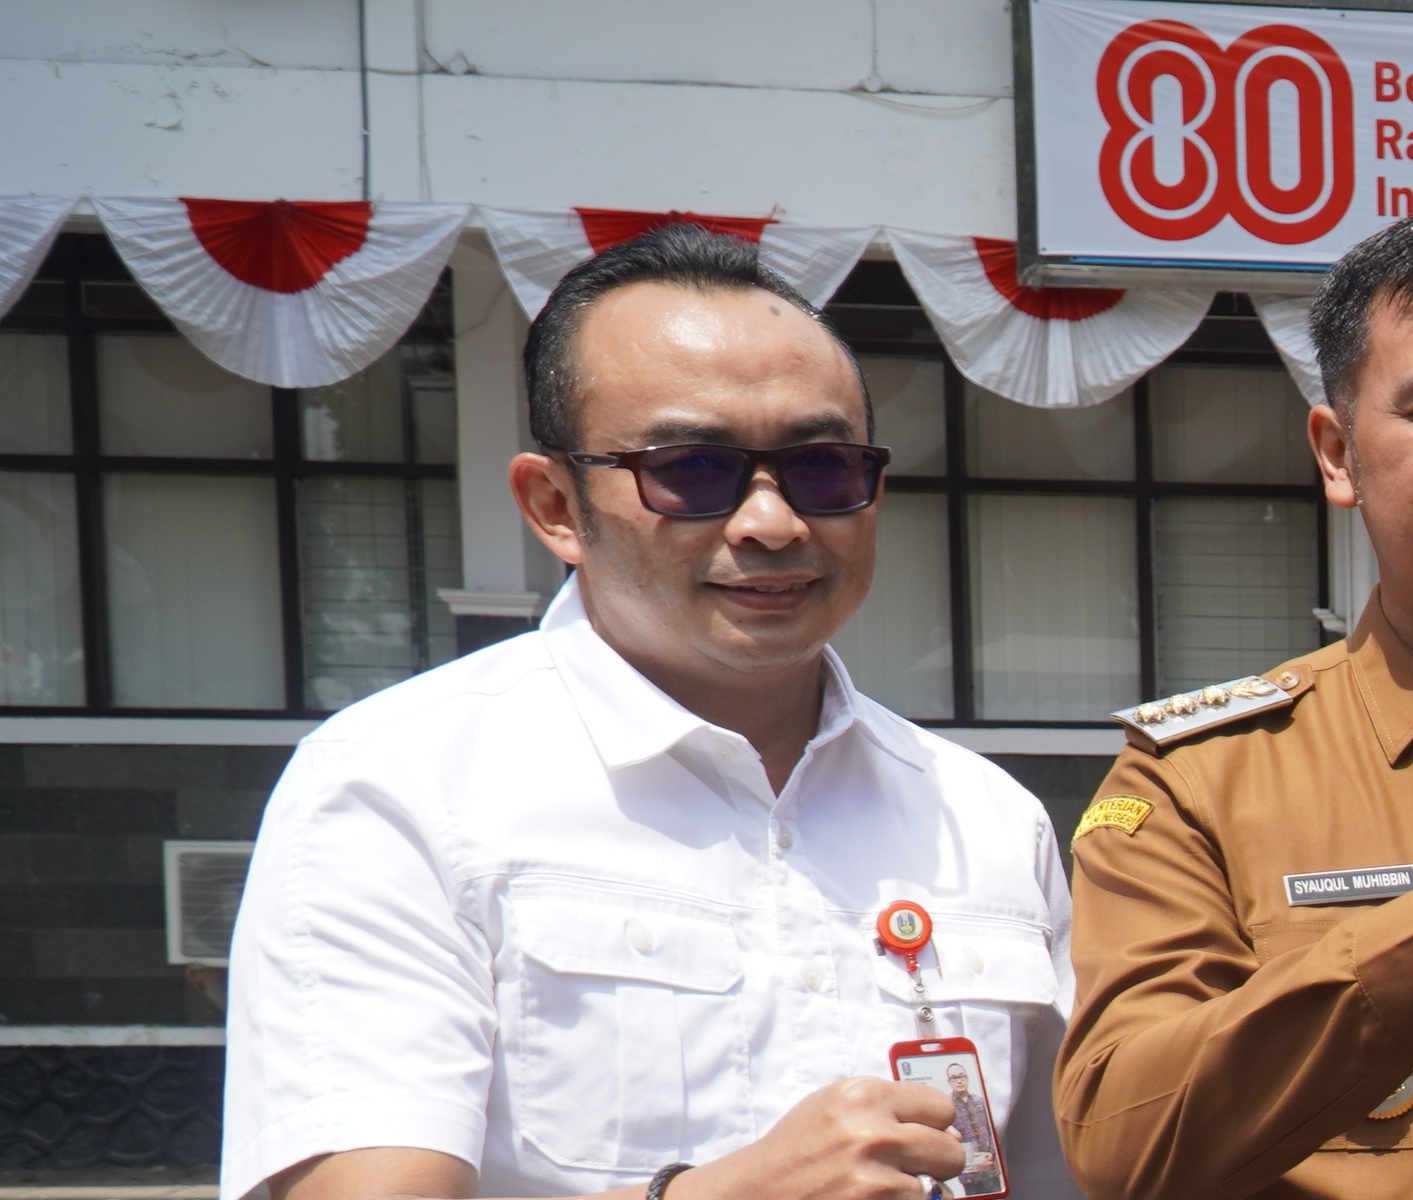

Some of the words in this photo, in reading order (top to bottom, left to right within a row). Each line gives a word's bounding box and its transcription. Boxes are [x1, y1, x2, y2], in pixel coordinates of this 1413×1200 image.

[1097, 19, 1355, 245] 80
[1294, 876, 1350, 894] SYAUQUL
[1352, 871, 1411, 888] MUHIBBIN
